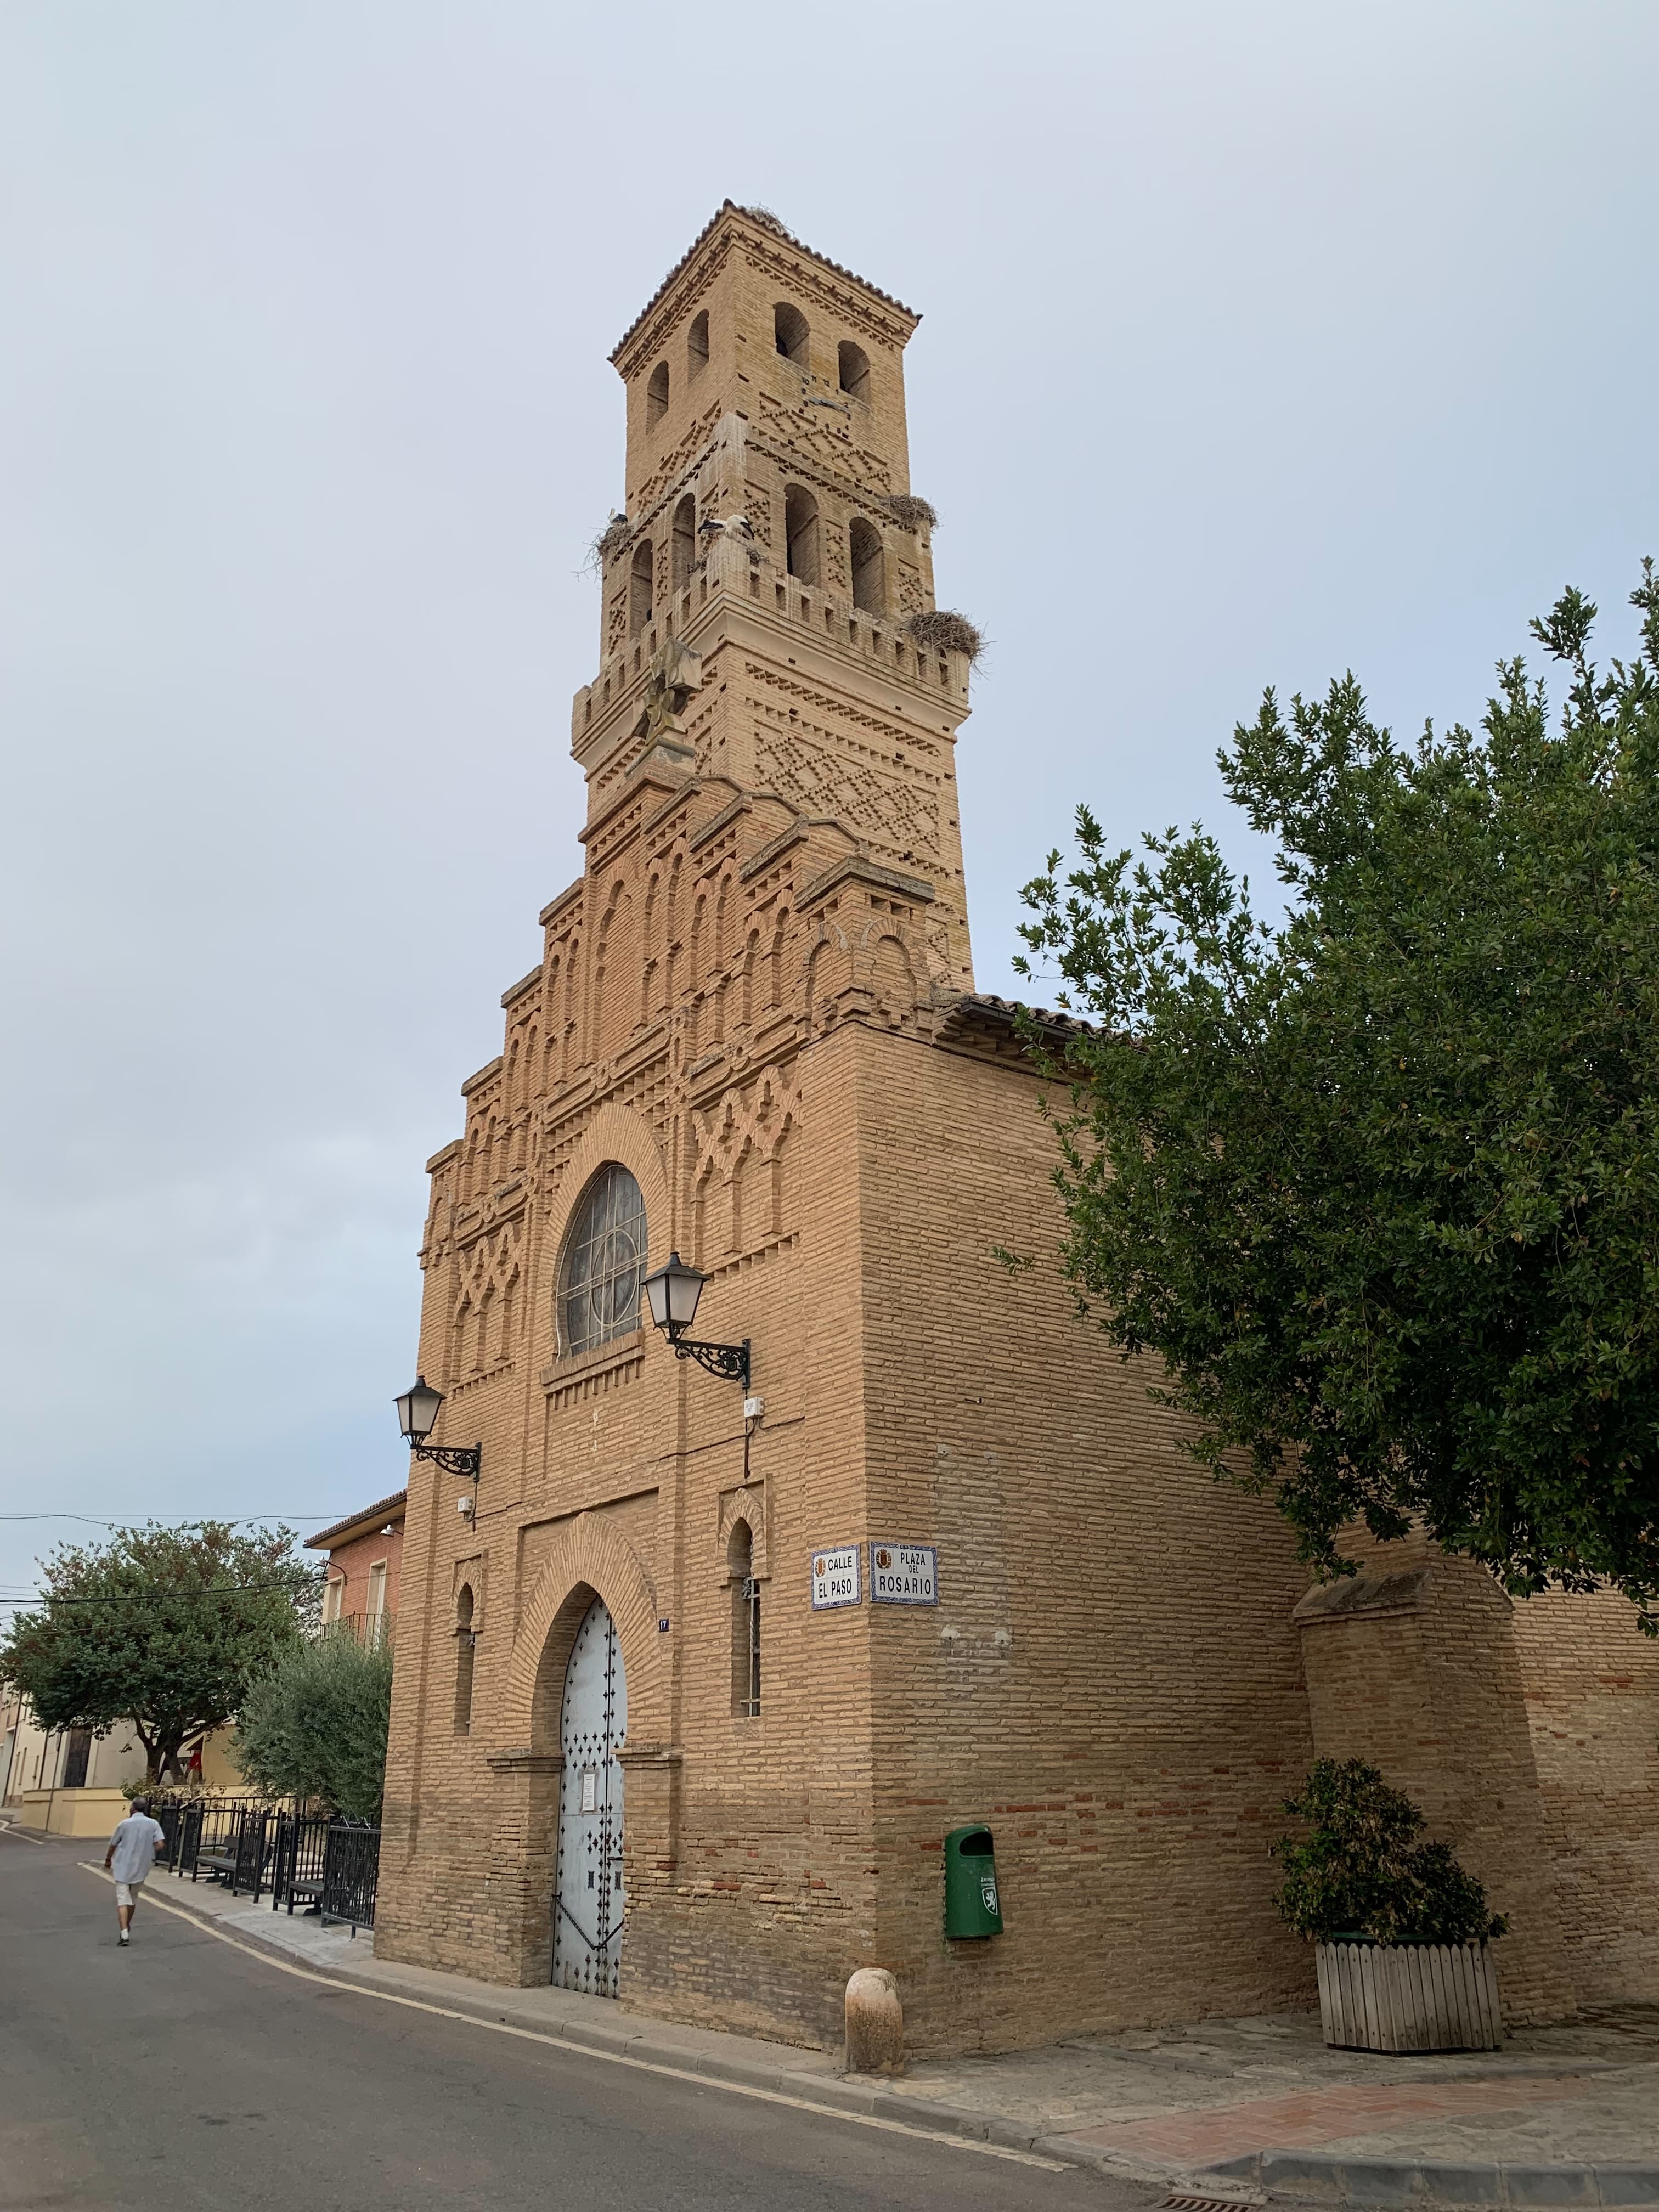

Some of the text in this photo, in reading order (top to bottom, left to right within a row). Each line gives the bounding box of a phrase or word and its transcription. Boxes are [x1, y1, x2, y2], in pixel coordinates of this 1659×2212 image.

[823, 379, 830, 387] 12
[828, 1556, 852, 1571] CALLE
[901, 1552, 926, 1565] PLAZA
[909, 1565, 919, 1573] DEL
[819, 1579, 851, 1598] EL PASO
[879, 1576, 931, 1595] ROSARIO
[661, 1621, 667, 1630] 17
